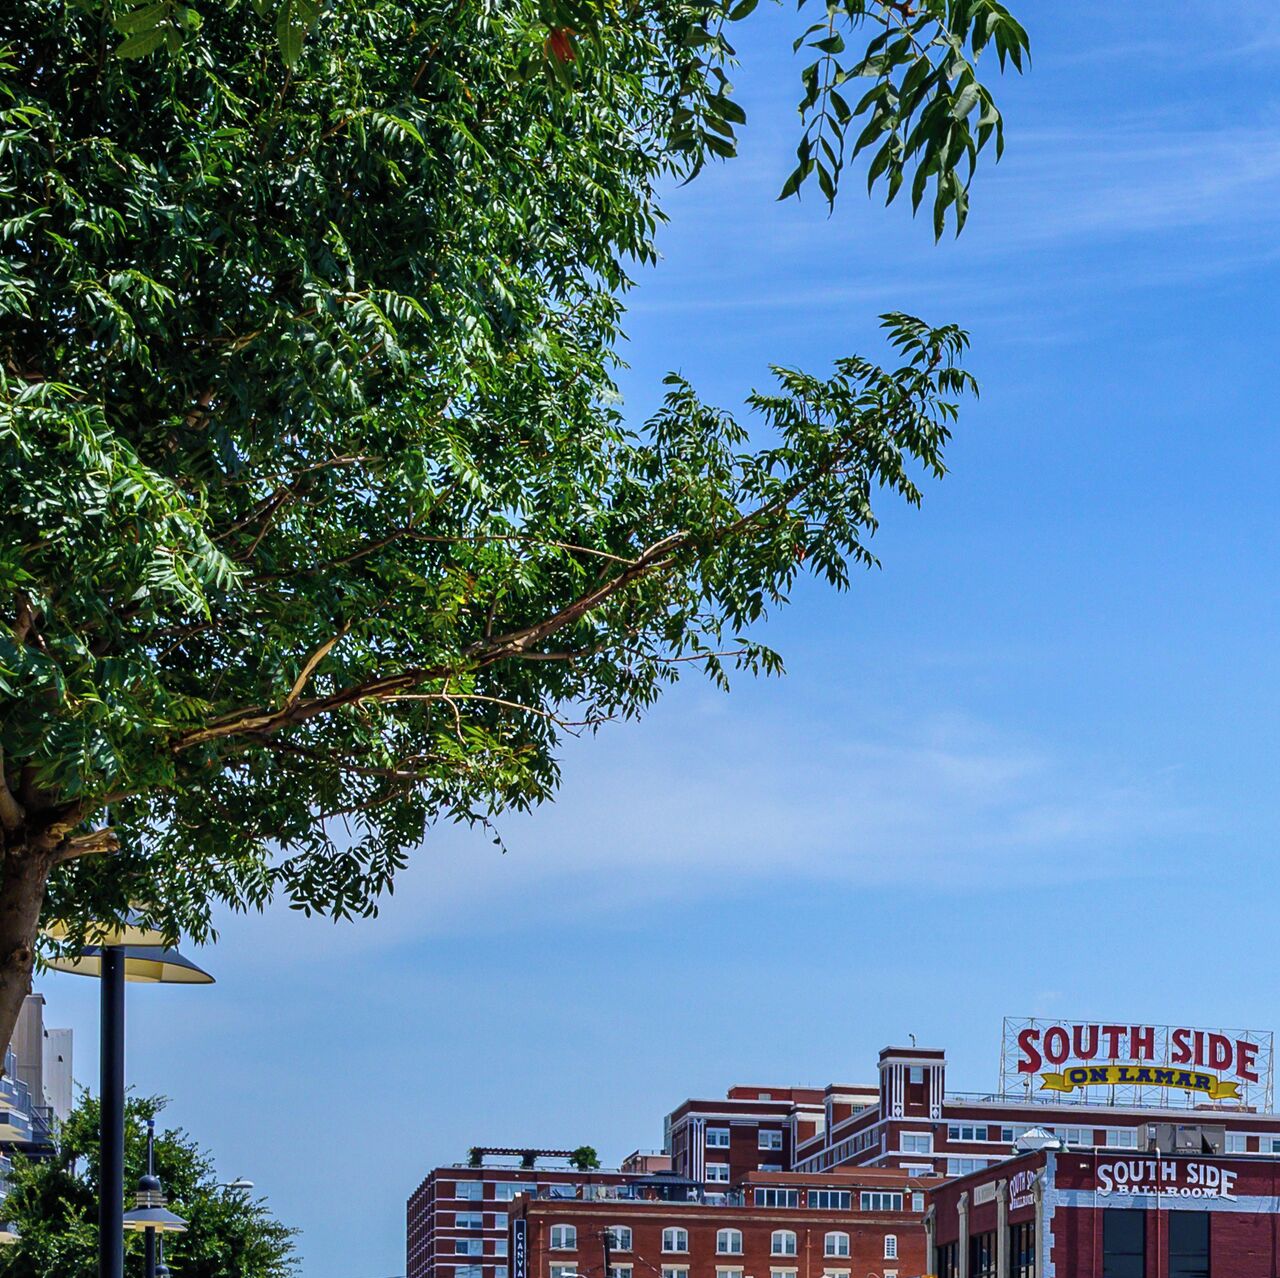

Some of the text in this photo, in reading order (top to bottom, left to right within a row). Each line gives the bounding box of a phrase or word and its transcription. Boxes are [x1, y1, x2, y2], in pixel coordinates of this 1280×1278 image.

[1018, 1025, 1259, 1083] SOUTH SIDE
[1069, 1067, 1211, 1090] ON LAMAR
[1097, 1161, 1238, 1203] SOUTH SIDE
[1116, 1184, 1220, 1199] BALLROOM
